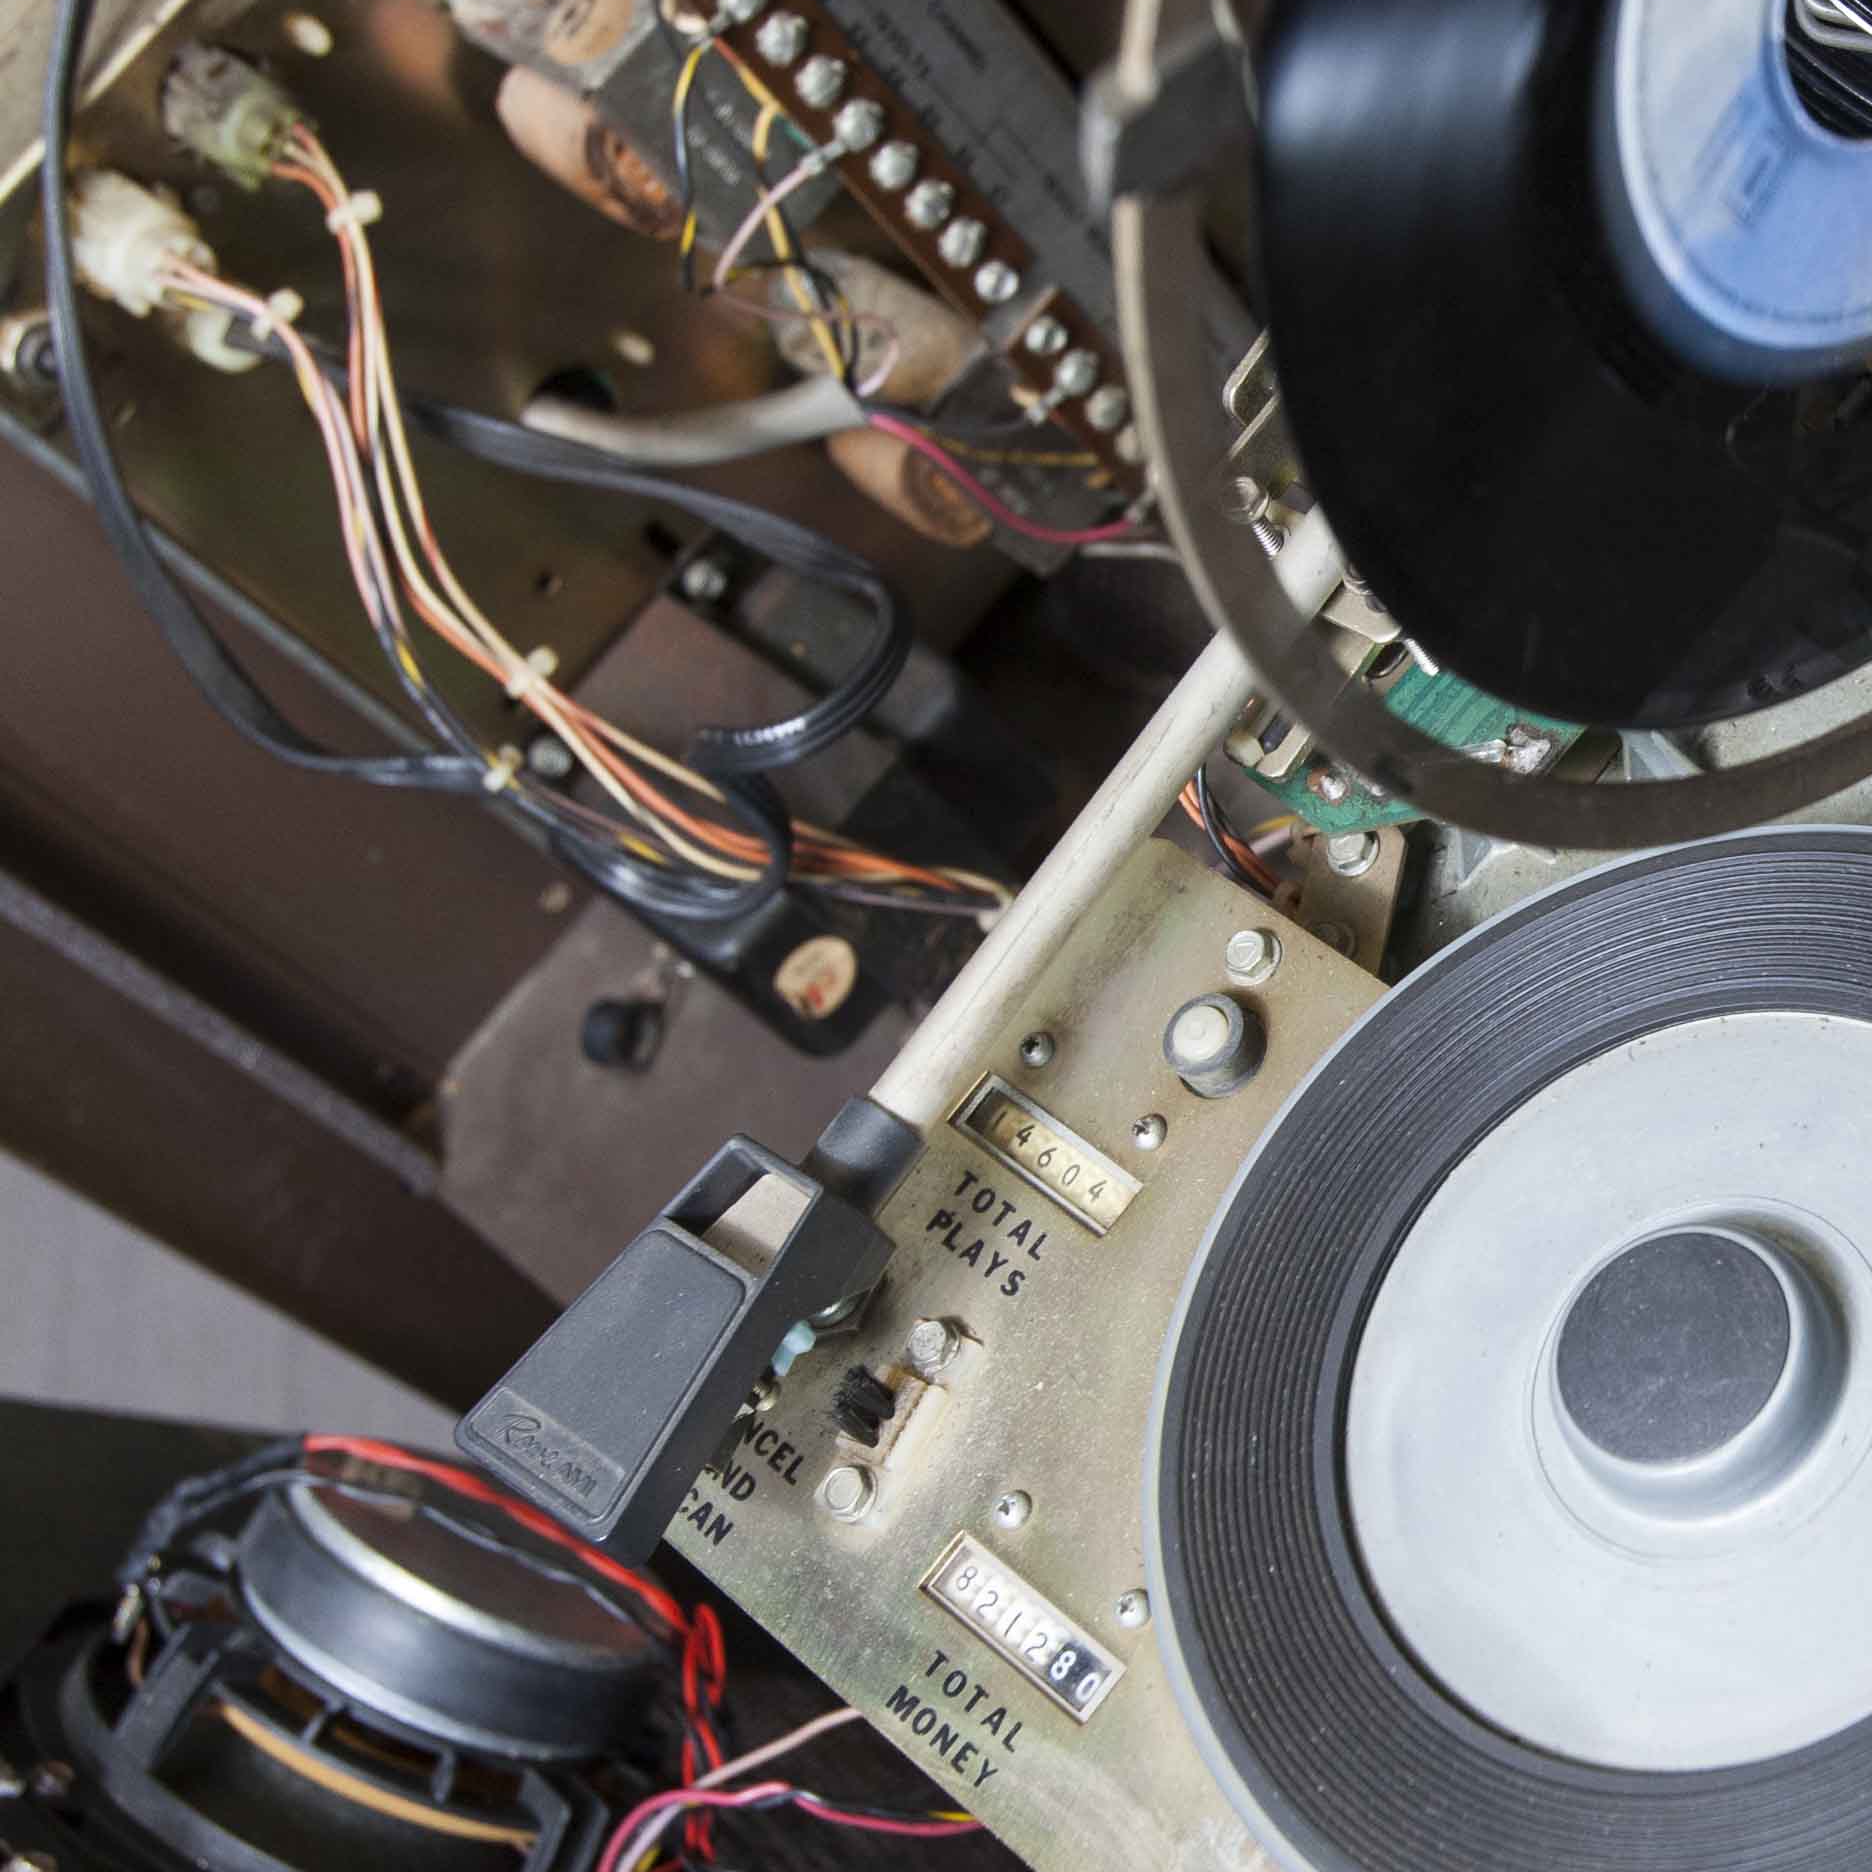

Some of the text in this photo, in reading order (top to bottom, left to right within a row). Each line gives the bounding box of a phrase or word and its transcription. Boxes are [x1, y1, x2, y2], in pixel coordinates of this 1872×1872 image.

[926, 1208, 1026, 1296] PLAYS
[954, 1170, 1047, 1261] TOTAL
[955, 1566, 1101, 1702] 821280
[886, 1685, 999, 1788] MONEY
[925, 1649, 1023, 1753] TOTAL
